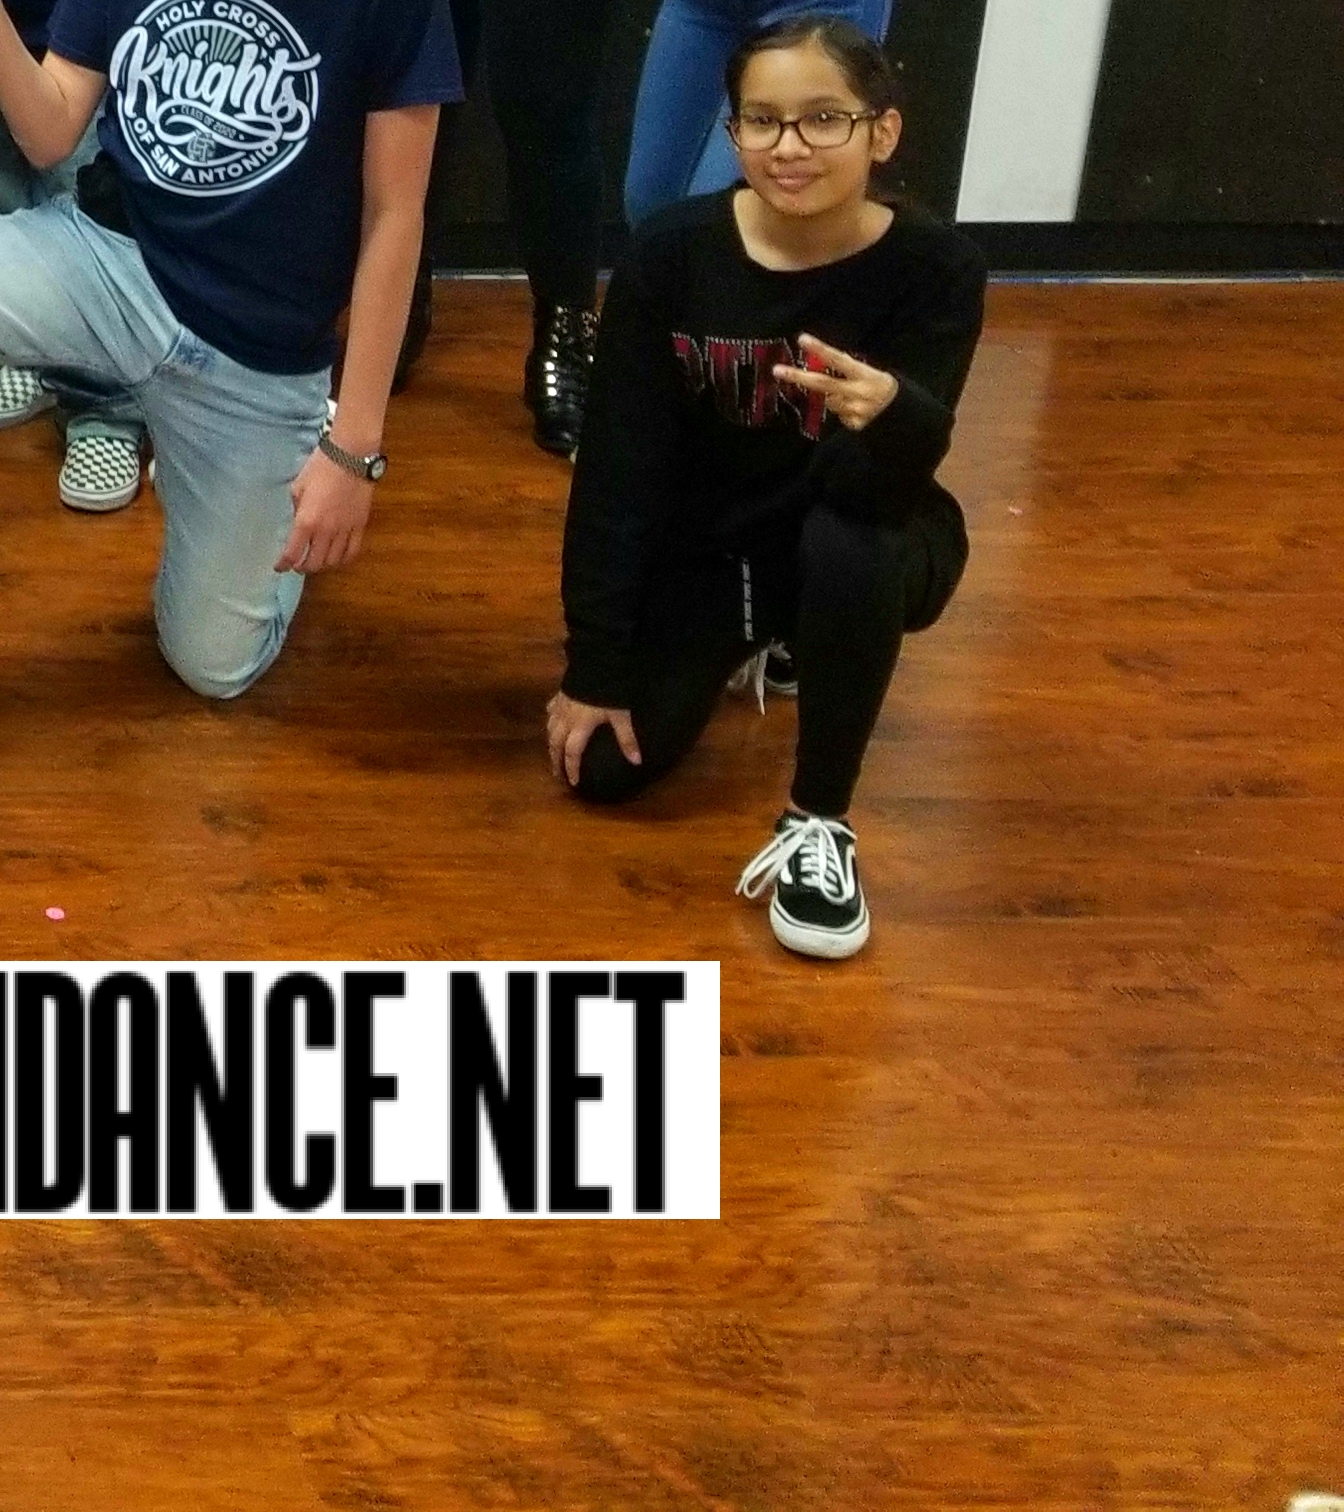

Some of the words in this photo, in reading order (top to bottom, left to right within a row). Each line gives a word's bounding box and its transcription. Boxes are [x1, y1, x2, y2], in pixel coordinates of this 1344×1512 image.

[155, 0, 206, 32] HOLY
[213, 1, 281, 48] CROSS
[110, 25, 322, 125] Knights
[180, 104, 204, 121] CLASS
[133, 117, 156, 145] OF
[150, 144, 180, 177] SAN
[180, 140, 279, 184] ANTONIO
